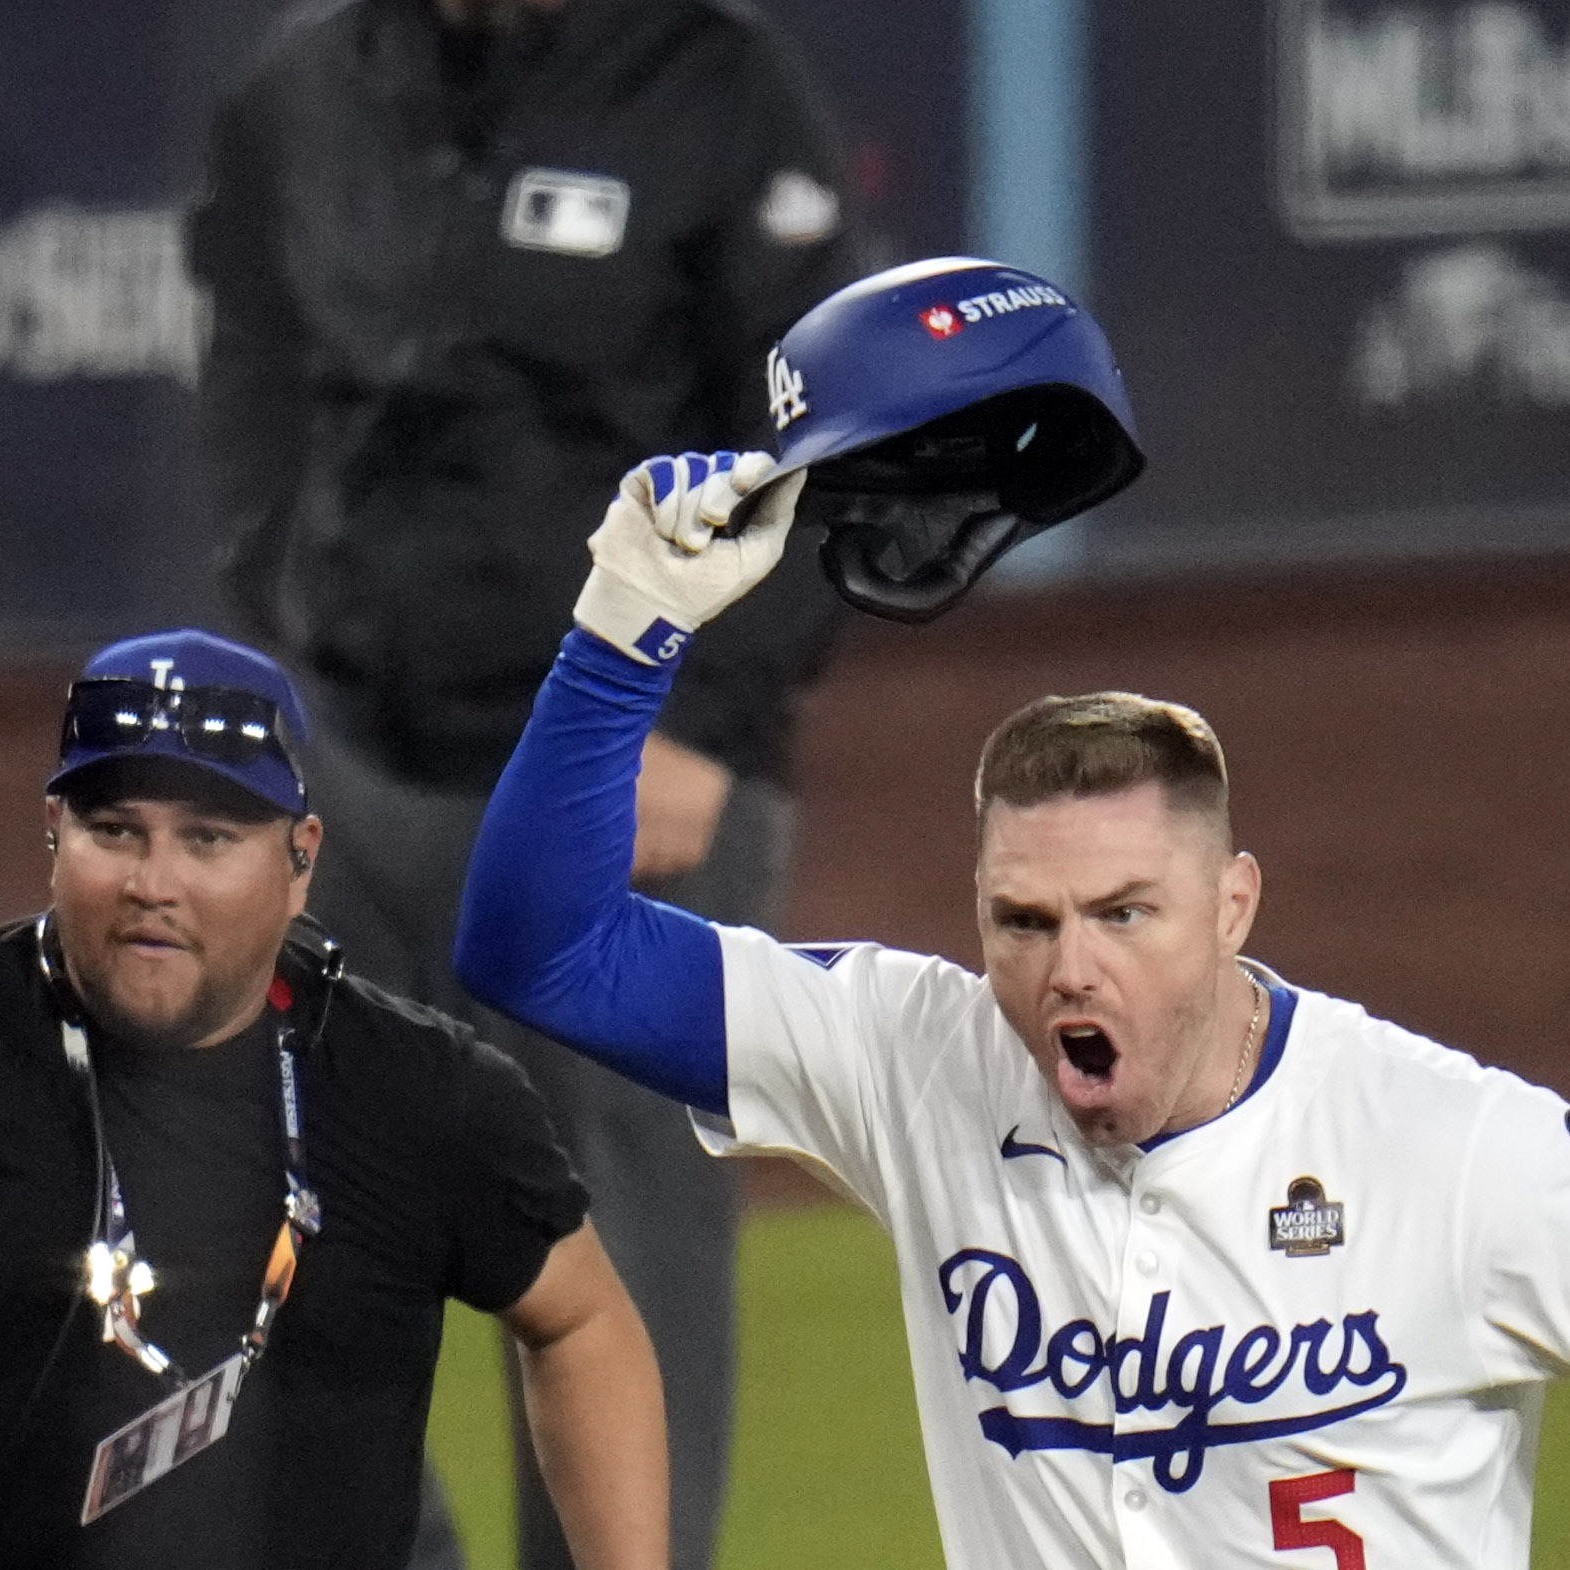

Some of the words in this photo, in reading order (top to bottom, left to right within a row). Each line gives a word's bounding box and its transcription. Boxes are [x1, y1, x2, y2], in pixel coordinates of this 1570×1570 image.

[657, 631, 687, 660] 5
[1273, 1208, 1340, 1228] WORLD
[1275, 1222, 1338, 1241] SERIES
[938, 1247, 1407, 1494] Dodgers
